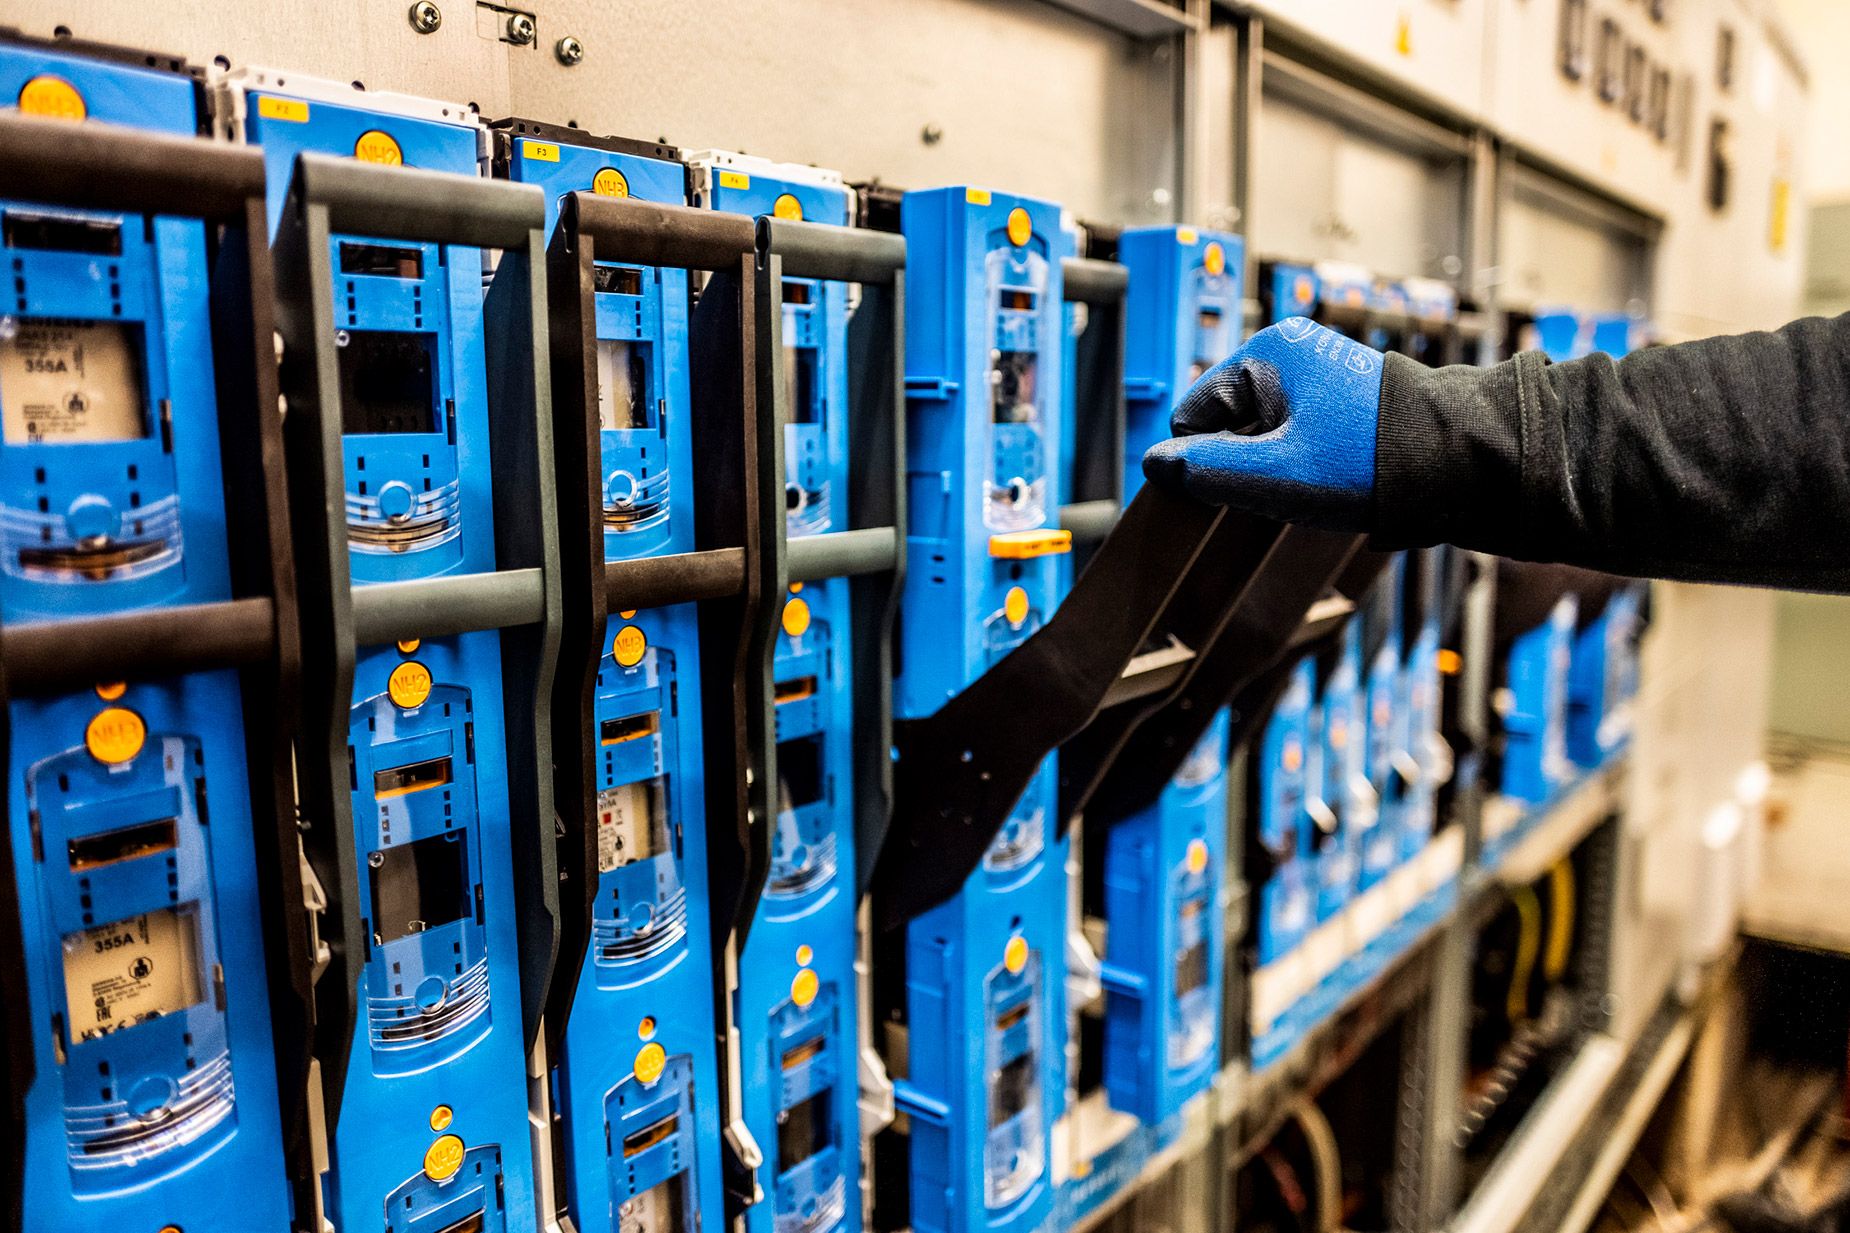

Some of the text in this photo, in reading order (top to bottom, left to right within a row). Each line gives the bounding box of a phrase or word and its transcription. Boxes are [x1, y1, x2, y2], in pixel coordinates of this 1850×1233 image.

[536, 147, 547, 156] F3
[393, 673, 428, 699] NH2
[94, 932, 135, 954] 355A
